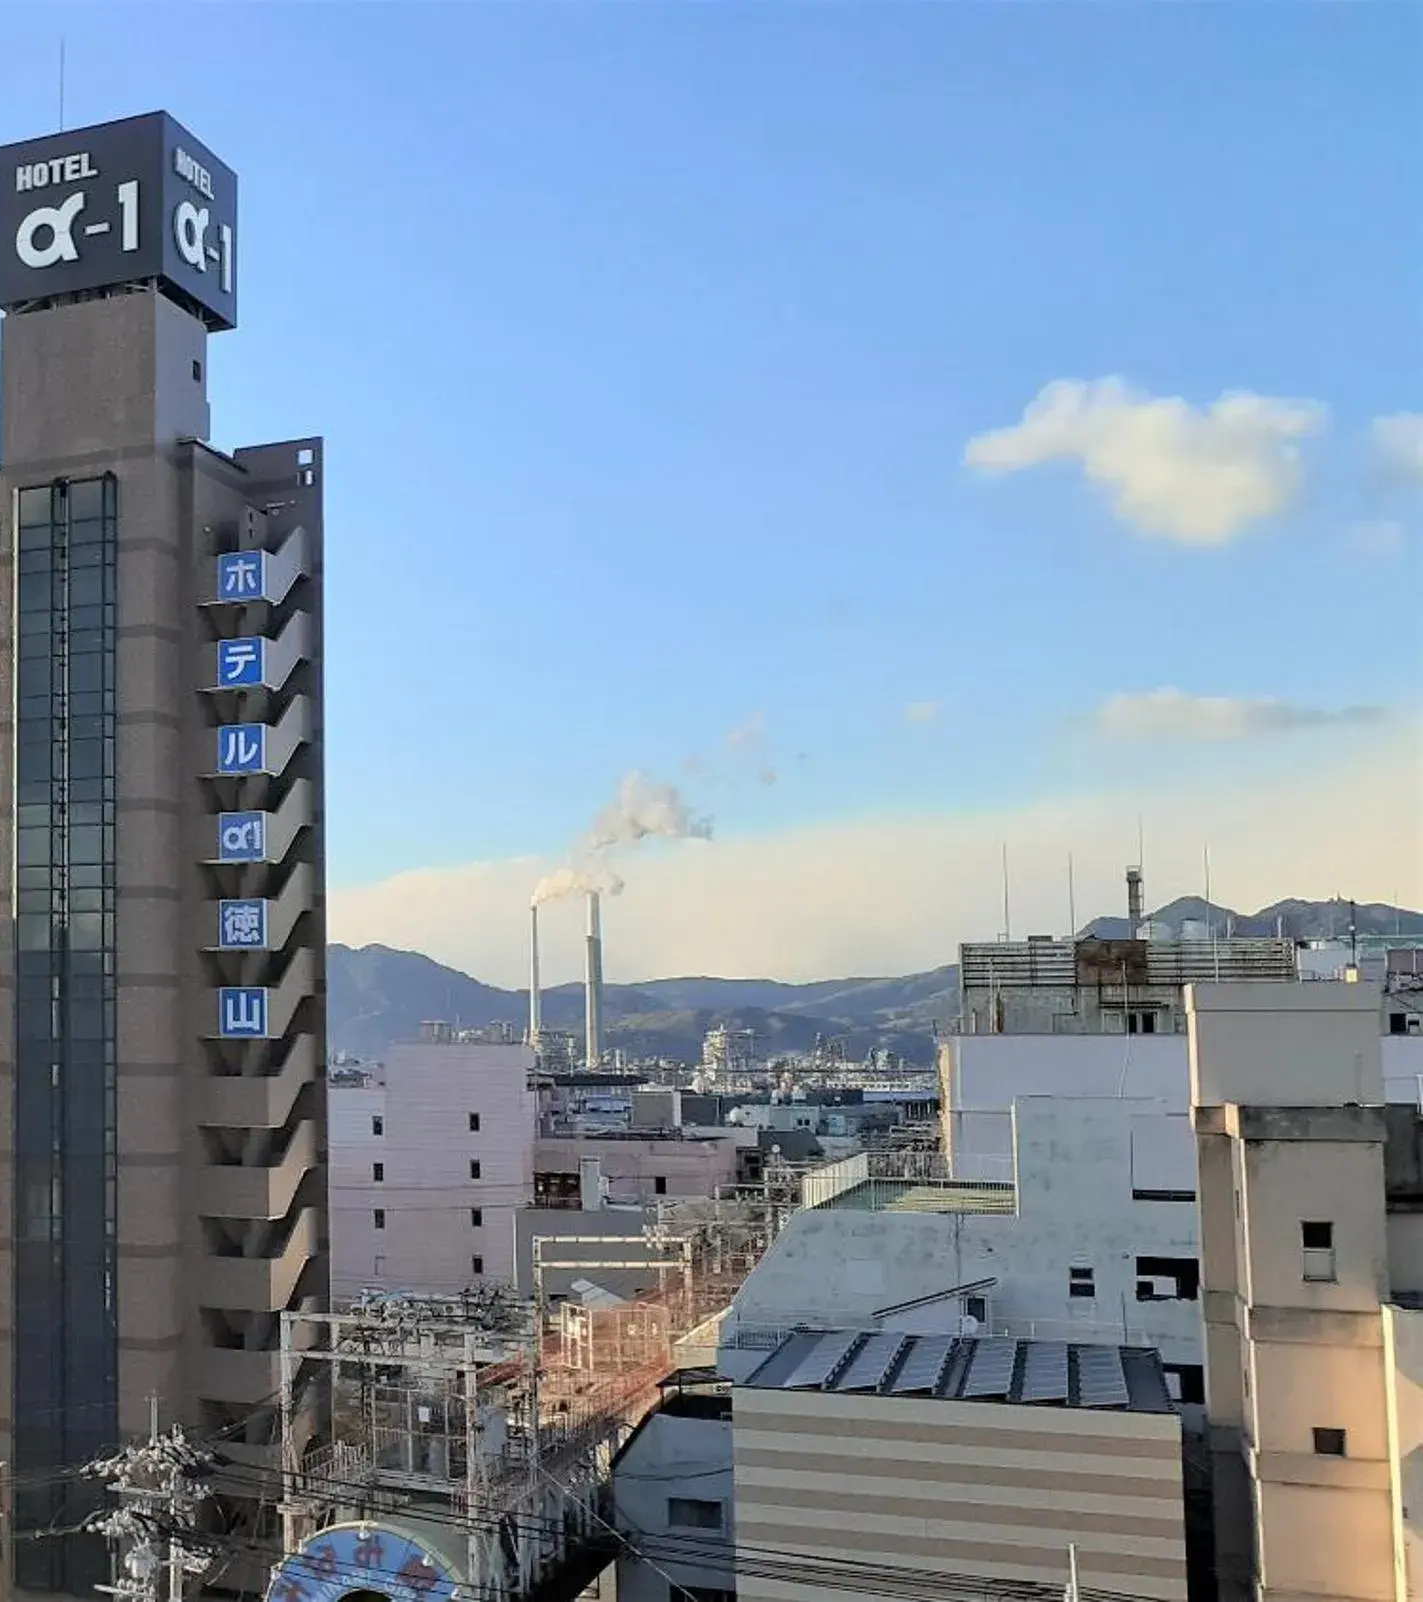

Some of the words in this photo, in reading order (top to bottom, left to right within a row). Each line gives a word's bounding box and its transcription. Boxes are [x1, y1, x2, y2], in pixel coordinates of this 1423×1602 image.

[16, 153, 98, 192] HOTEL
[176, 147, 214, 200] HOTEL
[225, 559, 258, 765] ホテル
[224, 905, 260, 1031] 徳山
